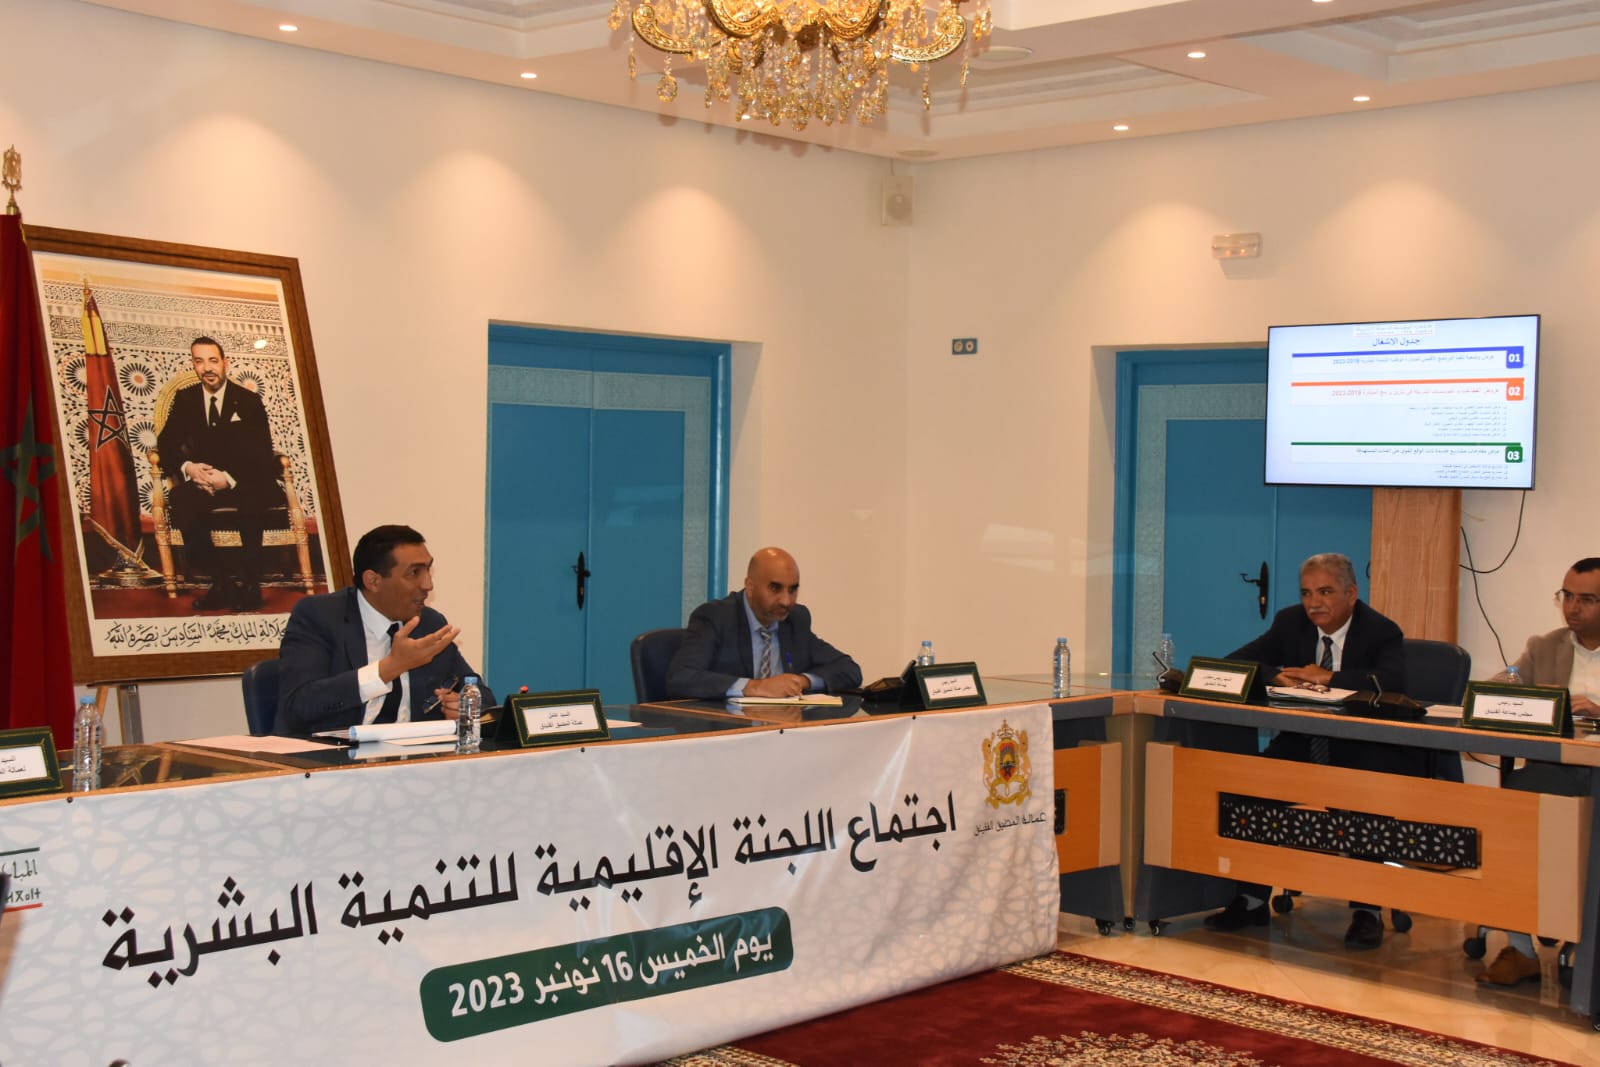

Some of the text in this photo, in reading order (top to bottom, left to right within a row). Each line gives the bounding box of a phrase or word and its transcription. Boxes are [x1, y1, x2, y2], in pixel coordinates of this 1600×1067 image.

[1508, 353, 1521, 363] 01
[1508, 386, 1521, 396] 02
[1507, 450, 1520, 461] 03
[102, 790, 956, 989] اجتماع اللجنة الإقليمية للتنمية البشرية
[448, 930, 775, 1017] يوم الخميس 16 نونبر 2023
